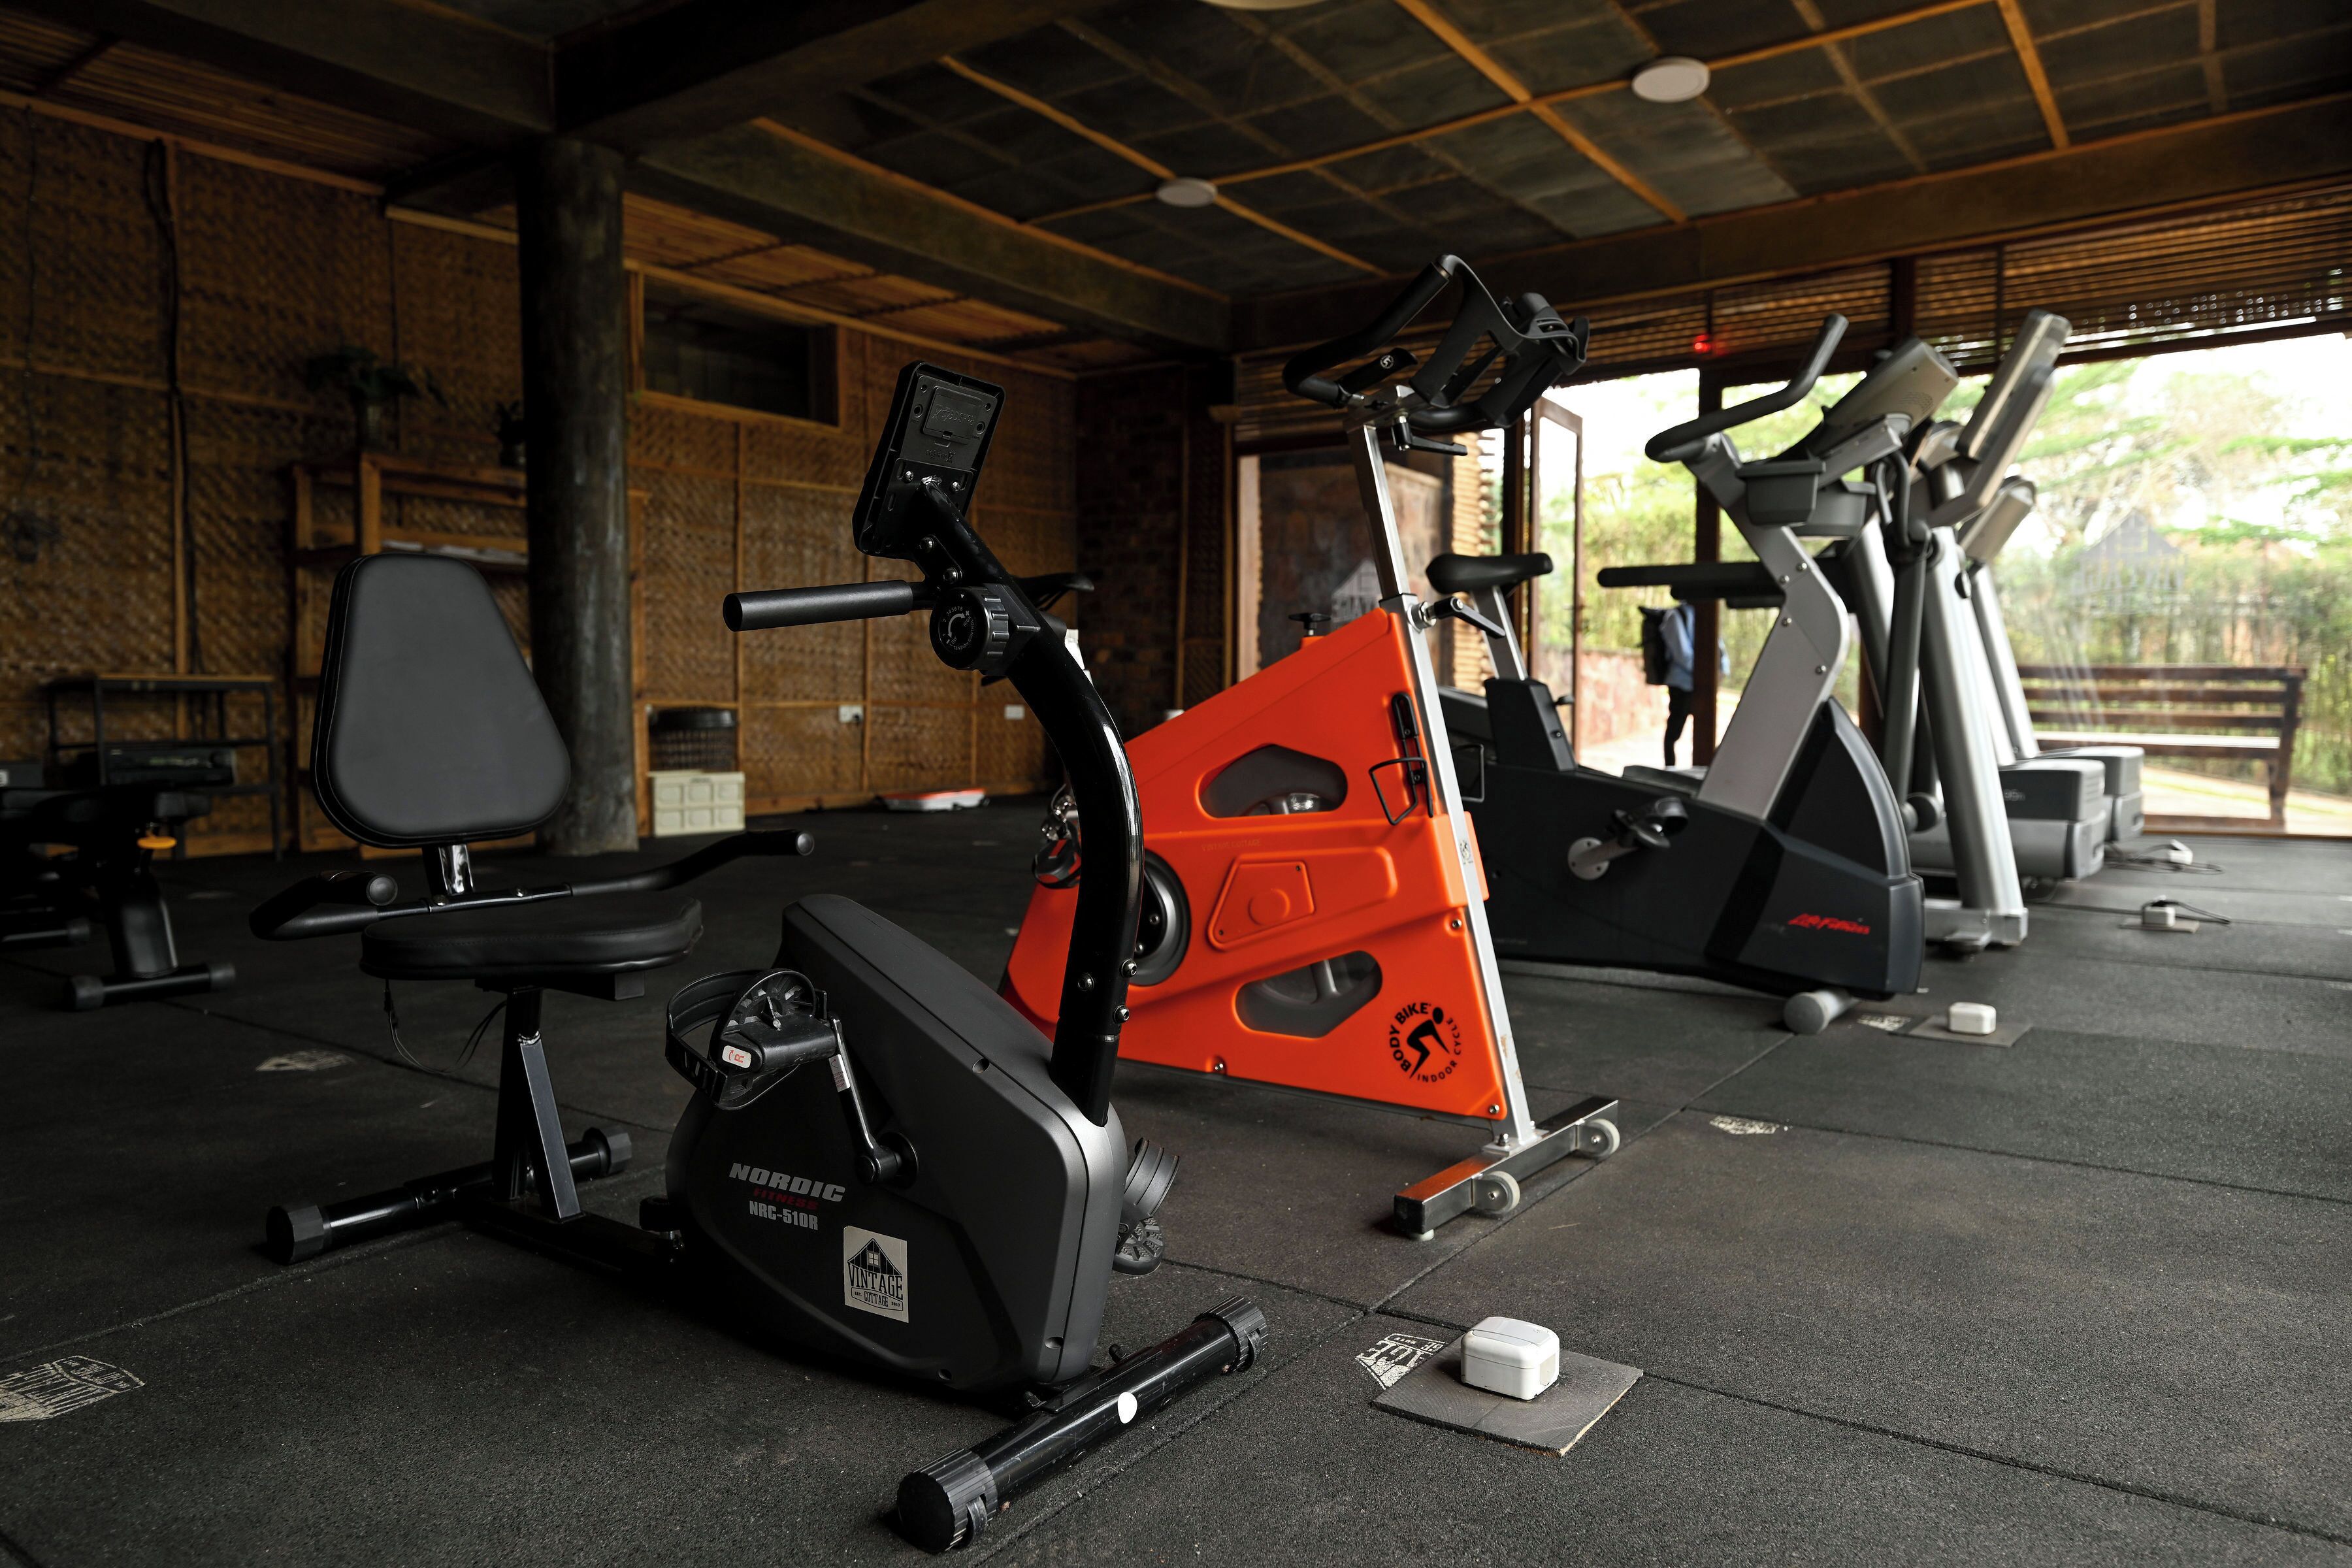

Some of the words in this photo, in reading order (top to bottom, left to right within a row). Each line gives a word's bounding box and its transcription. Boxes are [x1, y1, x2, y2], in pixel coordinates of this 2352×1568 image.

[734, 1053, 745, 1063] R
[1389, 1024, 1411, 1071] BODY
[1417, 1060, 1458, 1083] INDOOR
[1446, 1018, 1461, 1055] CYCLE
[728, 1162, 846, 1202] NORDIC
[753, 1187, 819, 1211] FITNESS
[749, 1200, 819, 1230] NRC-510R
[847, 1262, 904, 1300] VINTAGE
[864, 1291, 888, 1307] COTTAGE
